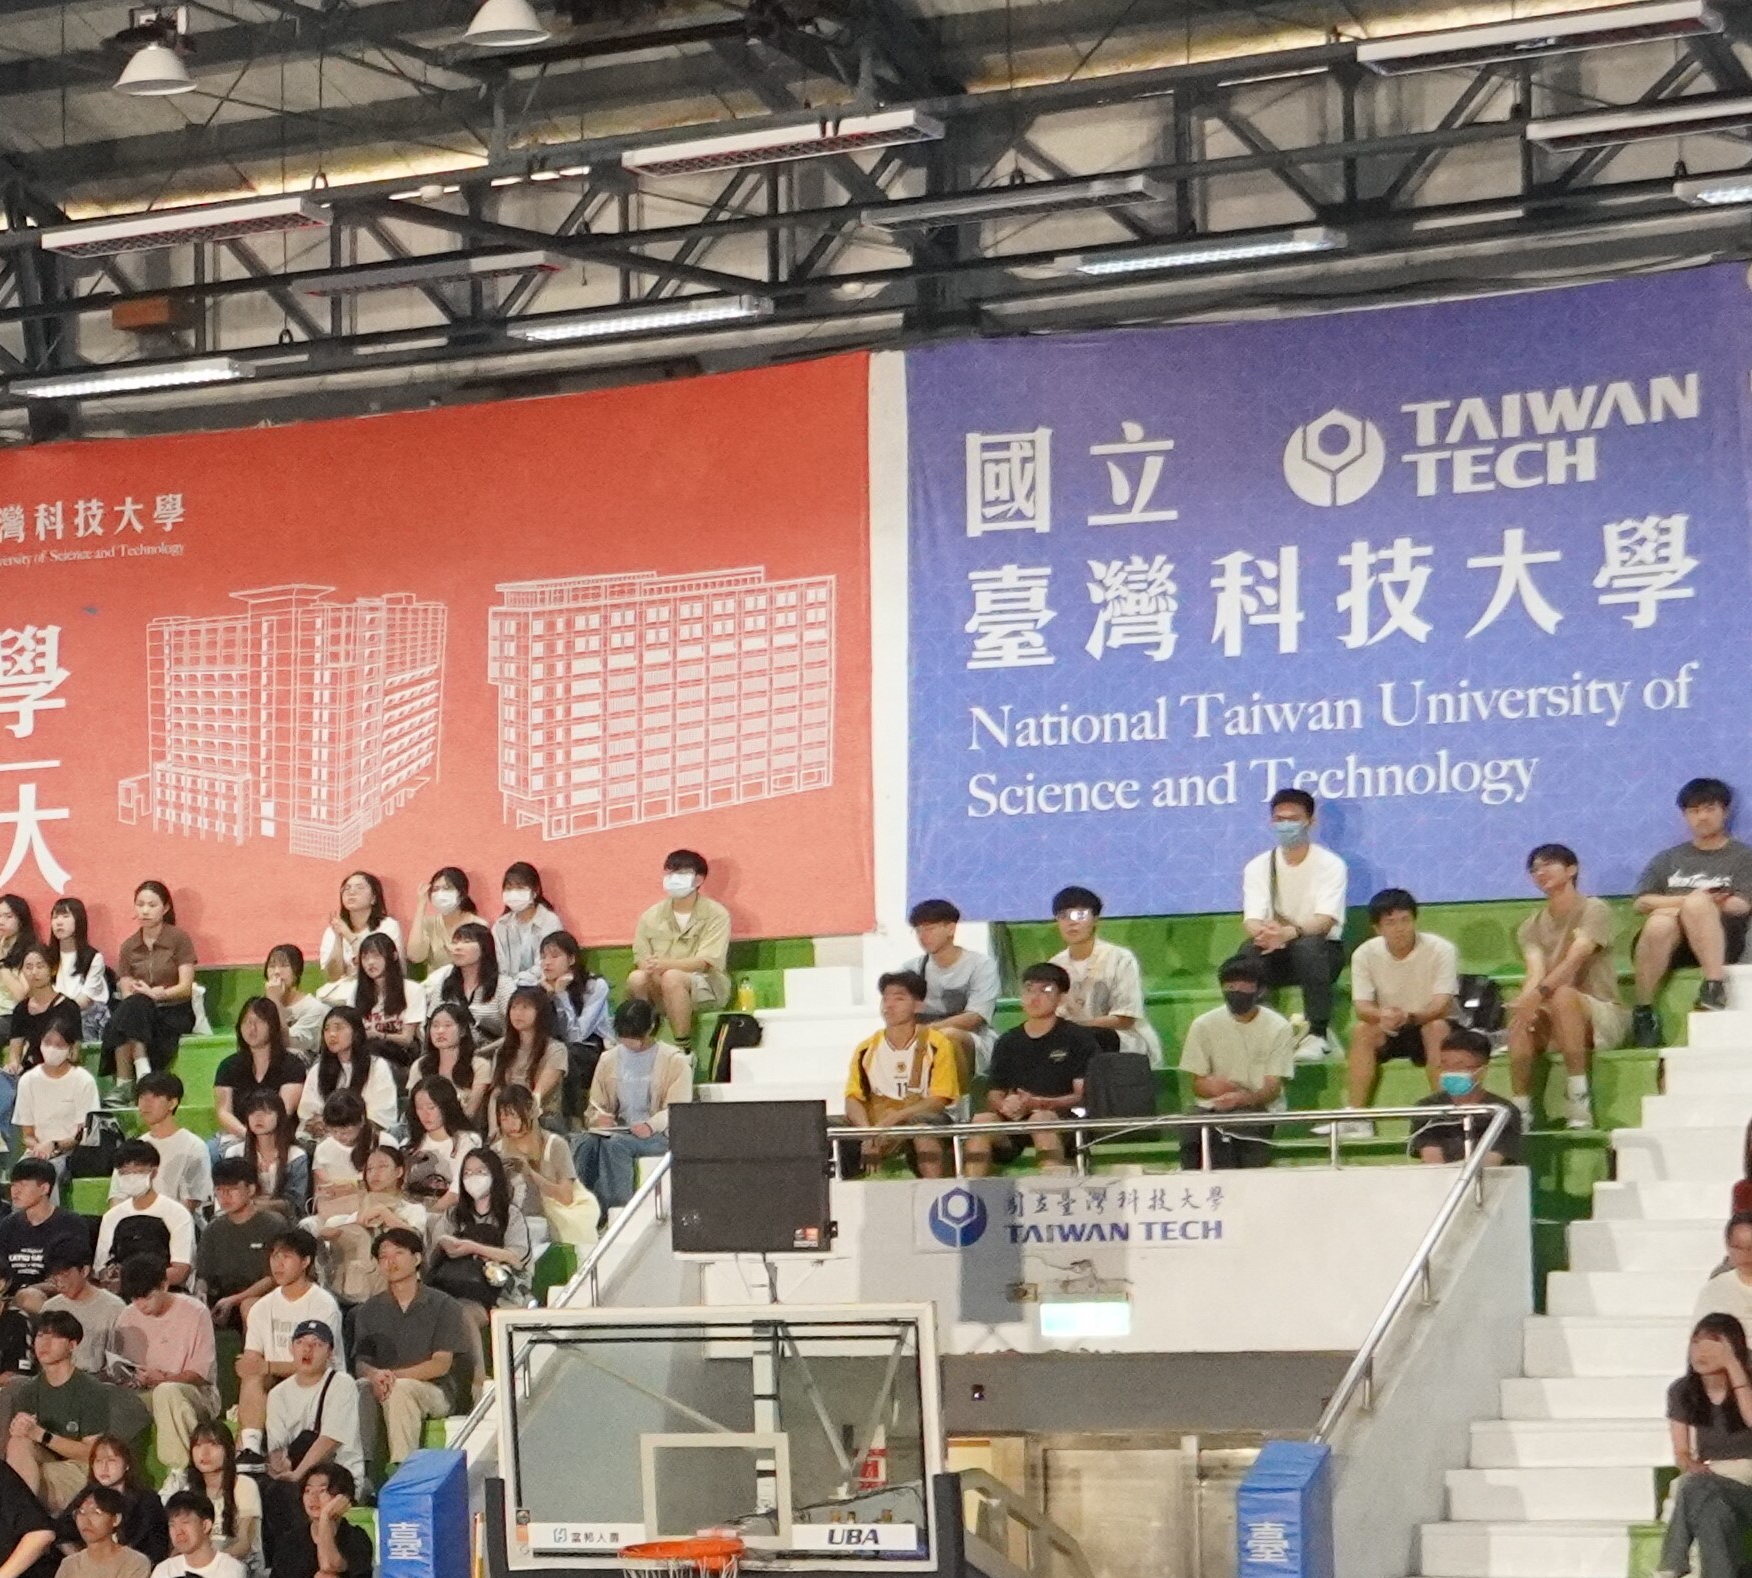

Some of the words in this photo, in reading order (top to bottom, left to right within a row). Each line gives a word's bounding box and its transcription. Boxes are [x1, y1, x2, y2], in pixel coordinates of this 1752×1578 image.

[1401, 373, 1701, 447] TAIWAN
[966, 420, 1179, 537] 國立
[1401, 437, 1598, 498] TECH
[33, 551, 47, 565] of
[49, 547, 92, 563] Science
[93, 545, 116, 559] and
[120, 541, 185, 560] Technology
[963, 512, 1700, 671] 臺灣科技大學
[967, 696, 1170, 751] National
[1179, 690, 1364, 740] Taiwan
[1377, 670, 1633, 729] University
[1641, 662, 1702, 712] of
[967, 771, 1141, 818] Science
[1150, 761, 1239, 808] and
[1248, 748, 1541, 806] Technology
[1003, 1221, 1129, 1244] TAIWAN
[1137, 1219, 1224, 1241] TECH
[827, 1528, 881, 1546] UBA
